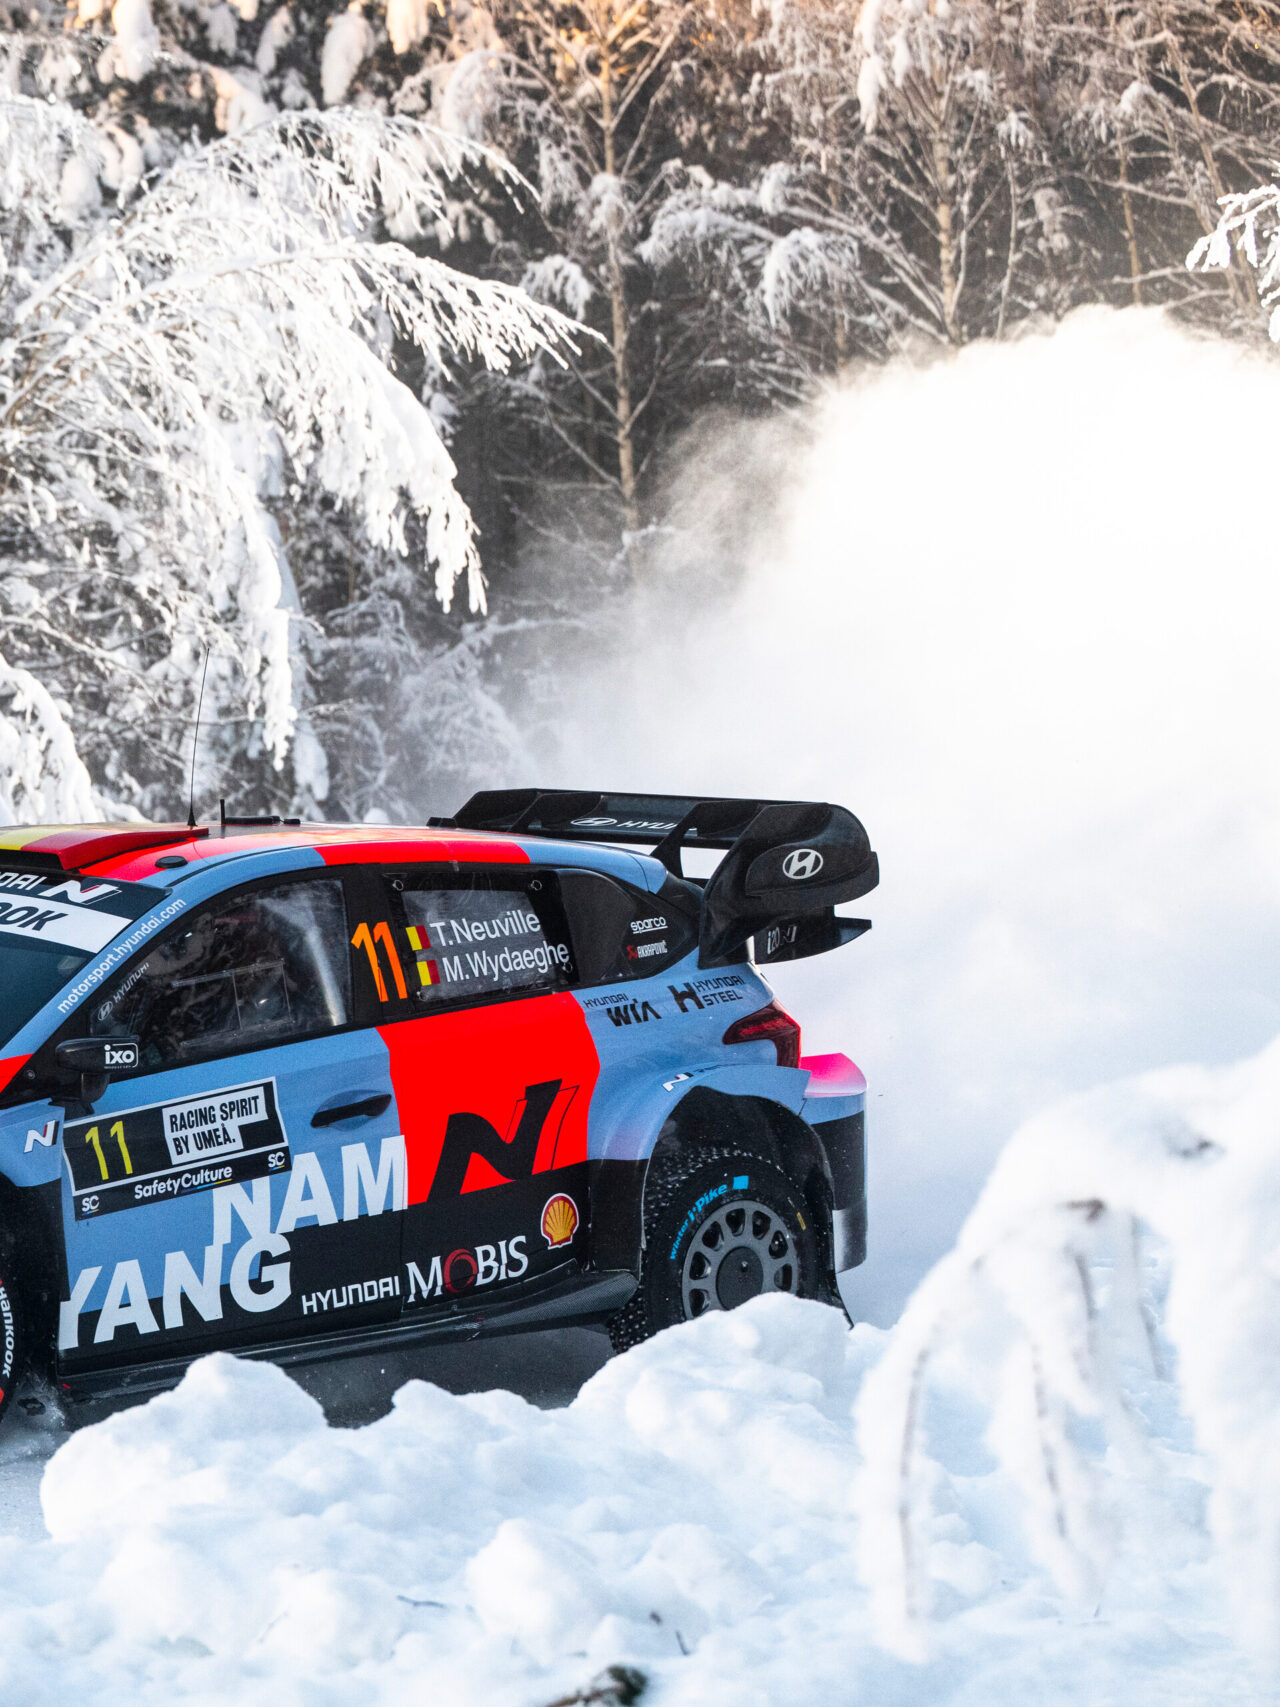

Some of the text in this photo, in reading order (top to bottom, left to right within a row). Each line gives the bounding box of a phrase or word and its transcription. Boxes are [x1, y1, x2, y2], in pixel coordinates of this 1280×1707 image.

[38, 880, 122, 905] N
[429, 909, 540, 946] T.Neuville
[630, 916, 668, 934] sparco
[57, 899, 187, 1013] motorsport.hyundai.com
[351, 921, 408, 1002] 11
[442, 940, 569, 982] M.Wydaeghe
[583, 993, 629, 1008] HYUNDAI
[692, 975, 745, 993] HYUNDAI
[701, 990, 743, 1006] STEEL
[104, 1044, 135, 1064] ixo
[169, 1095, 260, 1133] RACING SPIRIT
[85, 1121, 133, 1181] 11
[173, 1123, 235, 1155] BY UMEÅ.
[267, 1151, 285, 1168] SC
[134, 1166, 232, 1200] SafetyCulture
[213, 1135, 408, 1244] NAM
[82, 1195, 100, 1212] SC
[301, 1236, 529, 1315] HYUNDAI MOBIS
